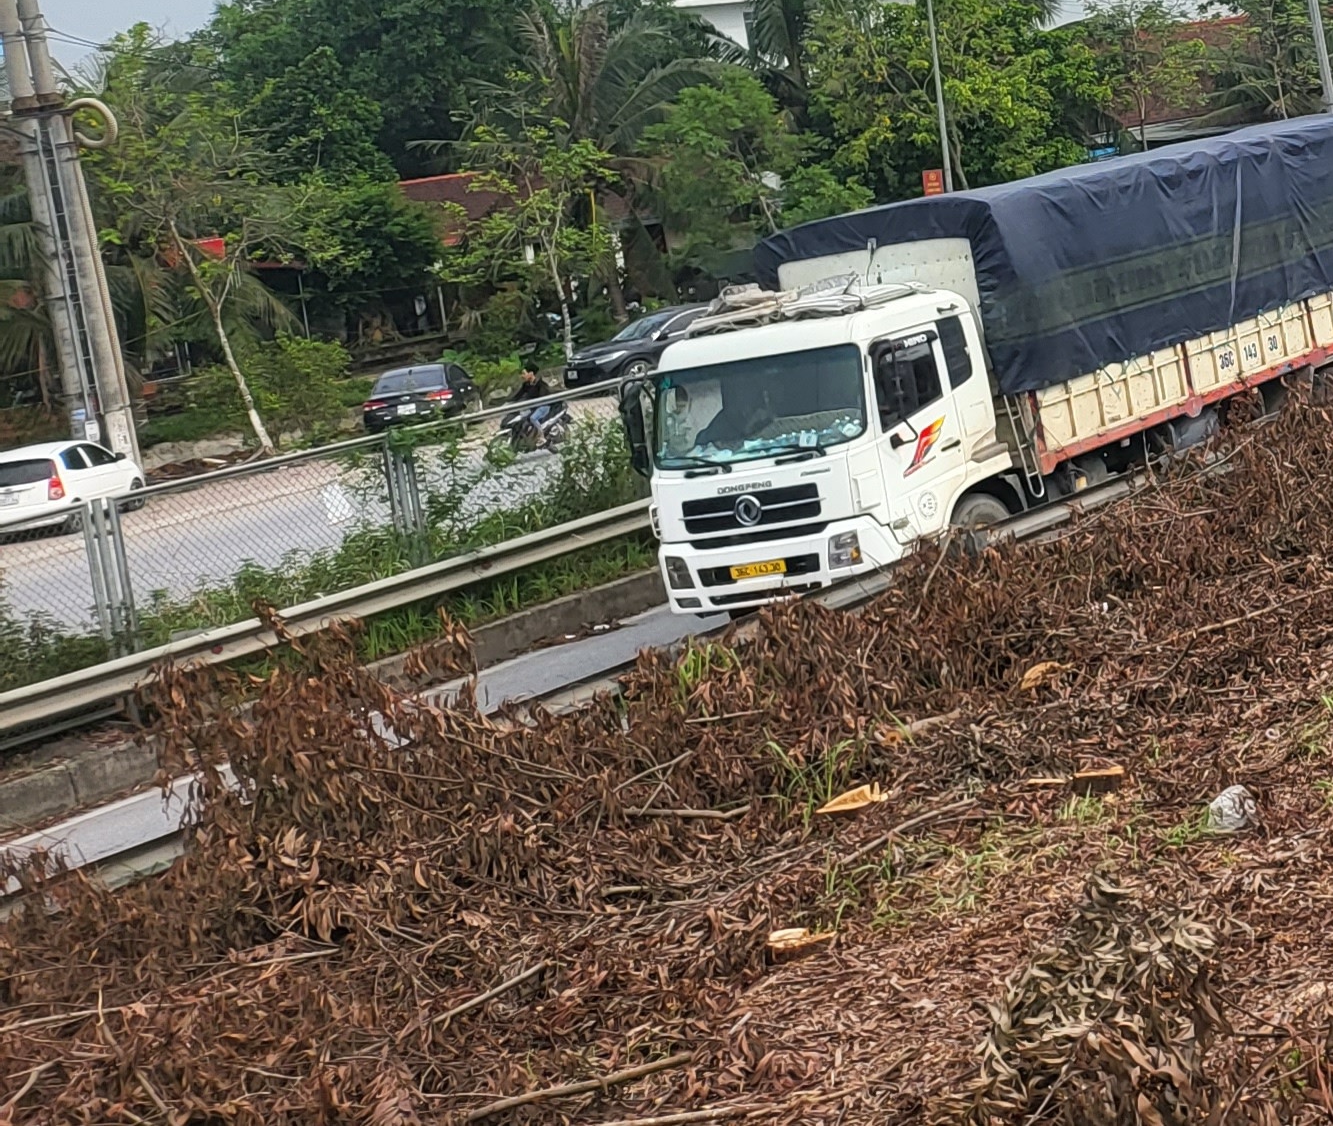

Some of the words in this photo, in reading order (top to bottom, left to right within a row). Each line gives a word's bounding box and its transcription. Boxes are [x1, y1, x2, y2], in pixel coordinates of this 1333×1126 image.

[1243, 342, 1258, 361] 143
[1267, 335, 1278, 352] 30
[717, 480, 773, 495] DONGFENG
